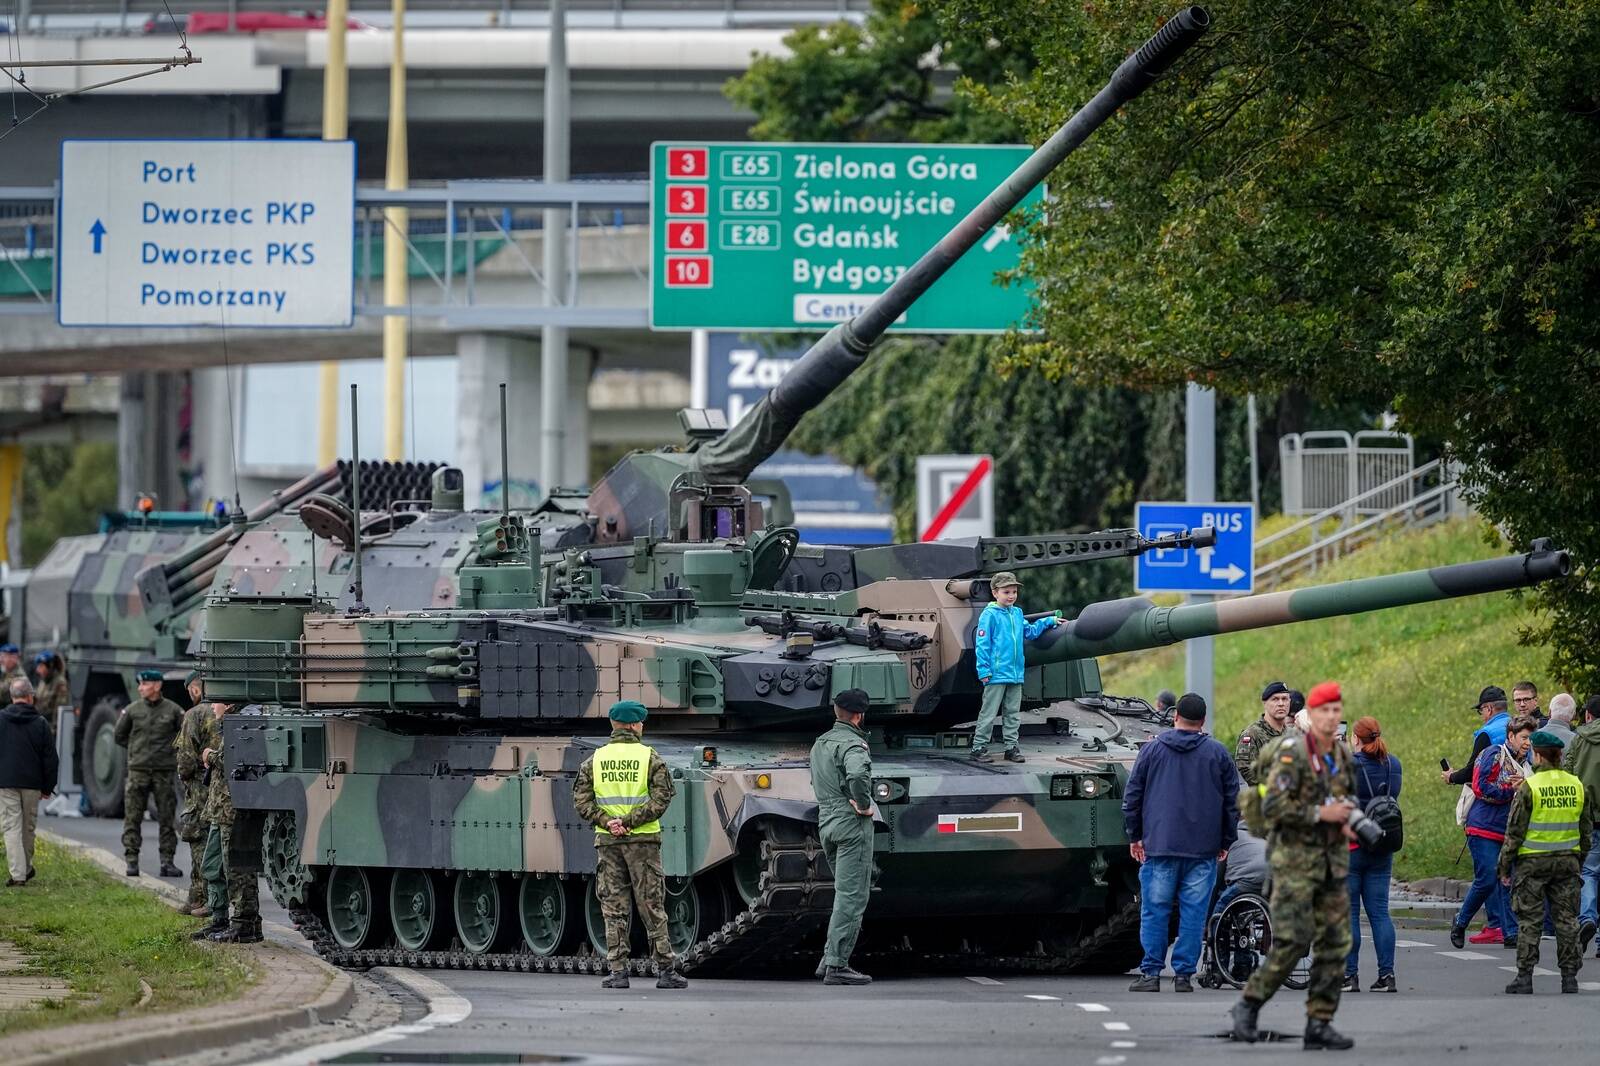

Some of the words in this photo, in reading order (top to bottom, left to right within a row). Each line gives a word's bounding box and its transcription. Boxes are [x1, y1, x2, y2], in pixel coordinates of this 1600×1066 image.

[142, 160, 196, 183] Port
[680, 152, 696, 174] 3
[731, 156, 771, 176] E65
[793, 154, 897, 180] Zielona
[906, 154, 978, 181] Góra
[680, 189, 695, 211] 3
[731, 190, 771, 211] E65
[792, 181, 956, 221] Świnoujście
[142, 201, 254, 225] Dworzec
[265, 202, 316, 225] PKP
[679, 225, 695, 247] 6
[730, 224, 771, 246] E28
[793, 223, 900, 249] Gdańsk
[141, 241, 254, 265] Dworzec
[265, 242, 316, 265] PKS
[675, 260, 701, 283] 10
[792, 257, 907, 291] Bydgosz
[141, 282, 287, 313] Pomorzany
[805, 299, 866, 318] Centr
[1201, 511, 1244, 533] BUS
[600, 759, 640, 771] WOJSKO
[601, 771, 639, 783] POLSKIE
[1539, 785, 1577, 798] WOJSKO
[1540, 797, 1577, 809] POLSKIE
